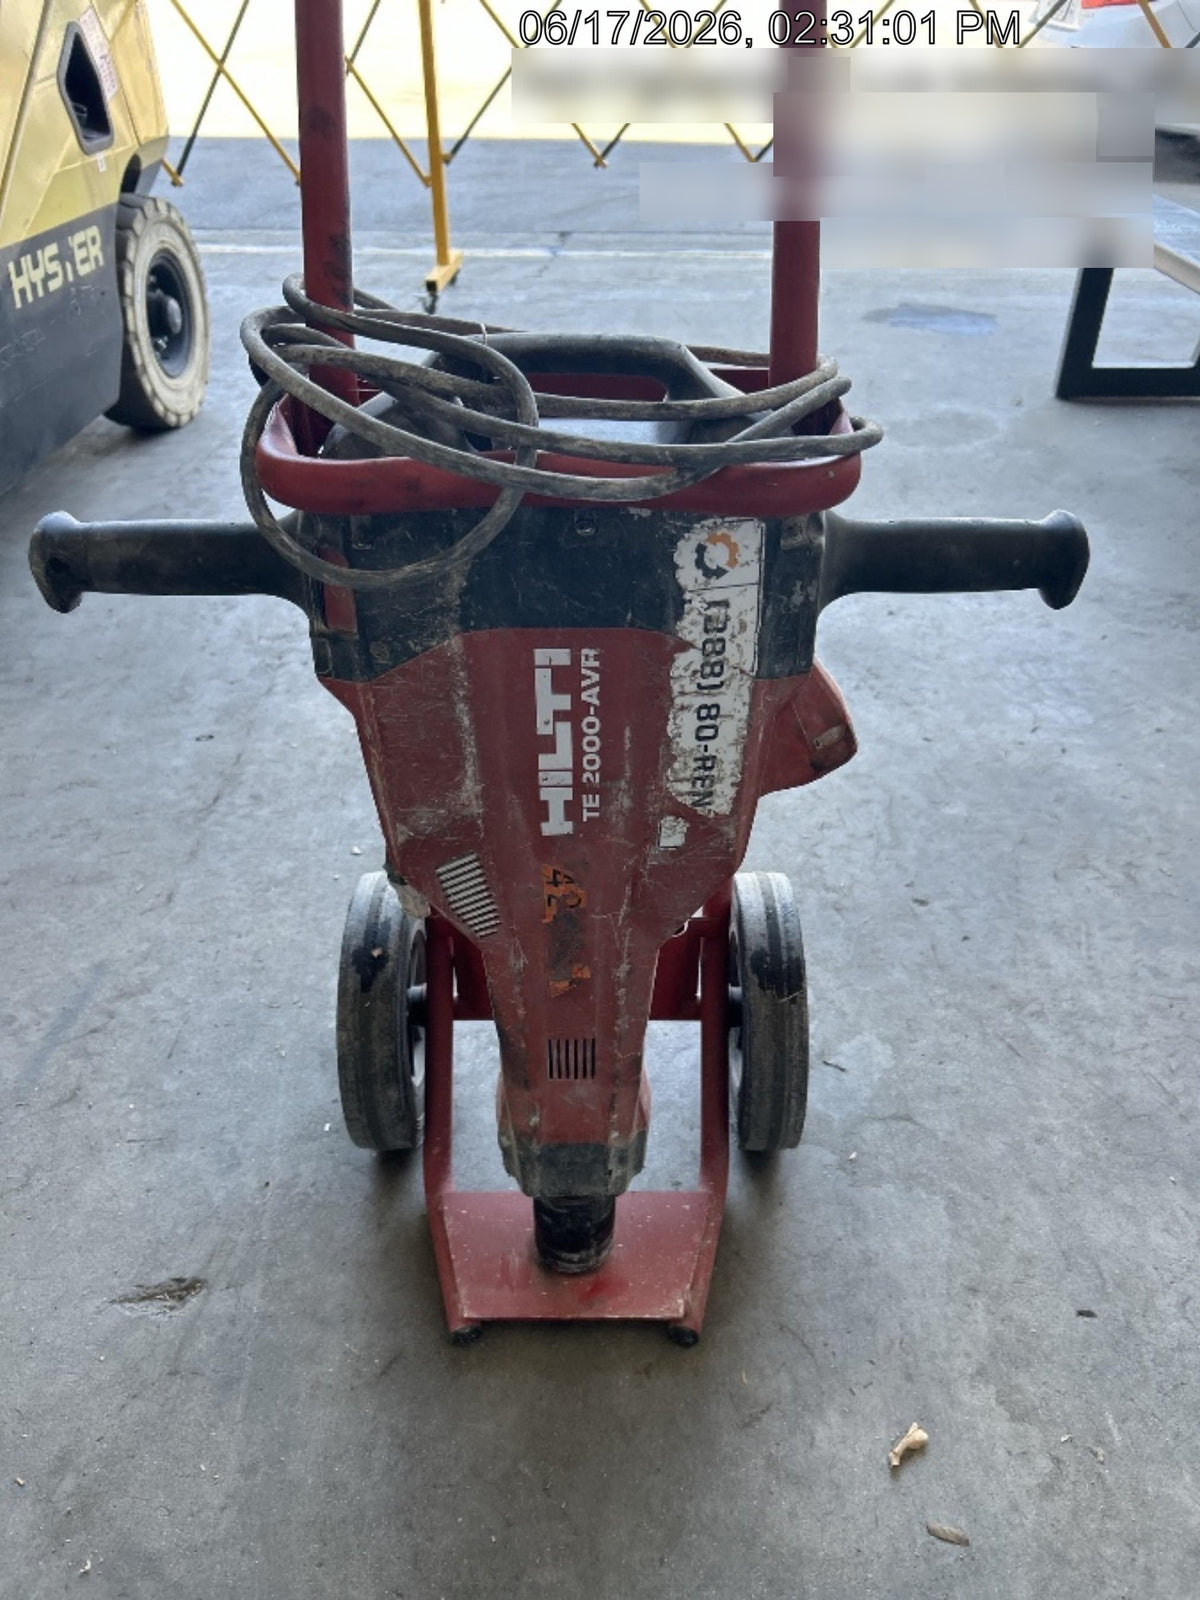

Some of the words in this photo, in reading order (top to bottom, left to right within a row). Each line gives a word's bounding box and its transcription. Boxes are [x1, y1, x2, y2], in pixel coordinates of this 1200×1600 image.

[534, 649, 573, 836] HILTI
[581, 648, 600, 784] 2000-AVR
[582, 794, 600, 822] TE
